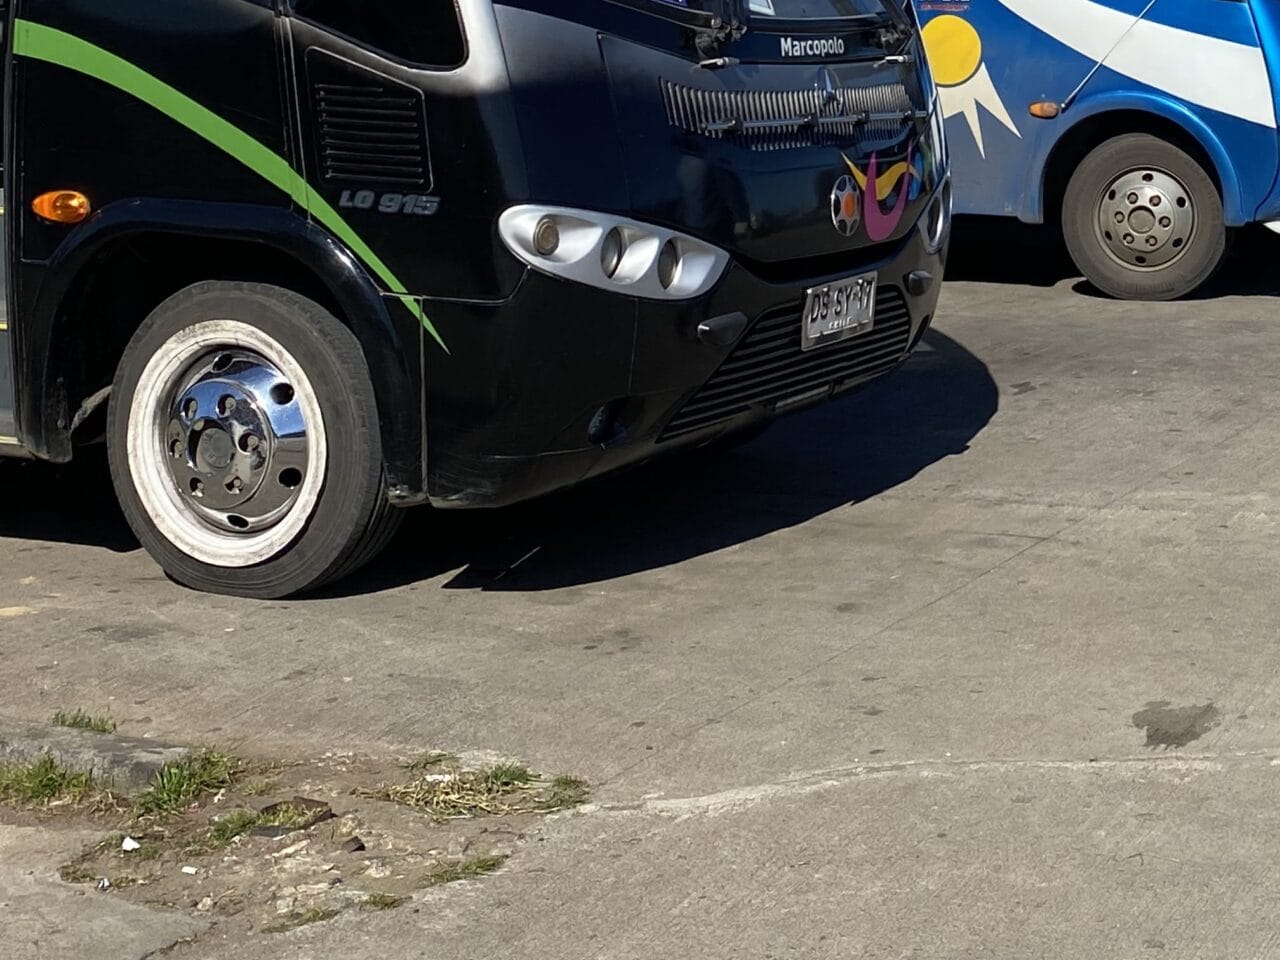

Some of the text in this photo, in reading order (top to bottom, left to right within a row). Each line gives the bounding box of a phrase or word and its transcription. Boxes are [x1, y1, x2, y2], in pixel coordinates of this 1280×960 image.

[780, 36, 845, 57] Marcopolo
[339, 189, 441, 215] LO 915
